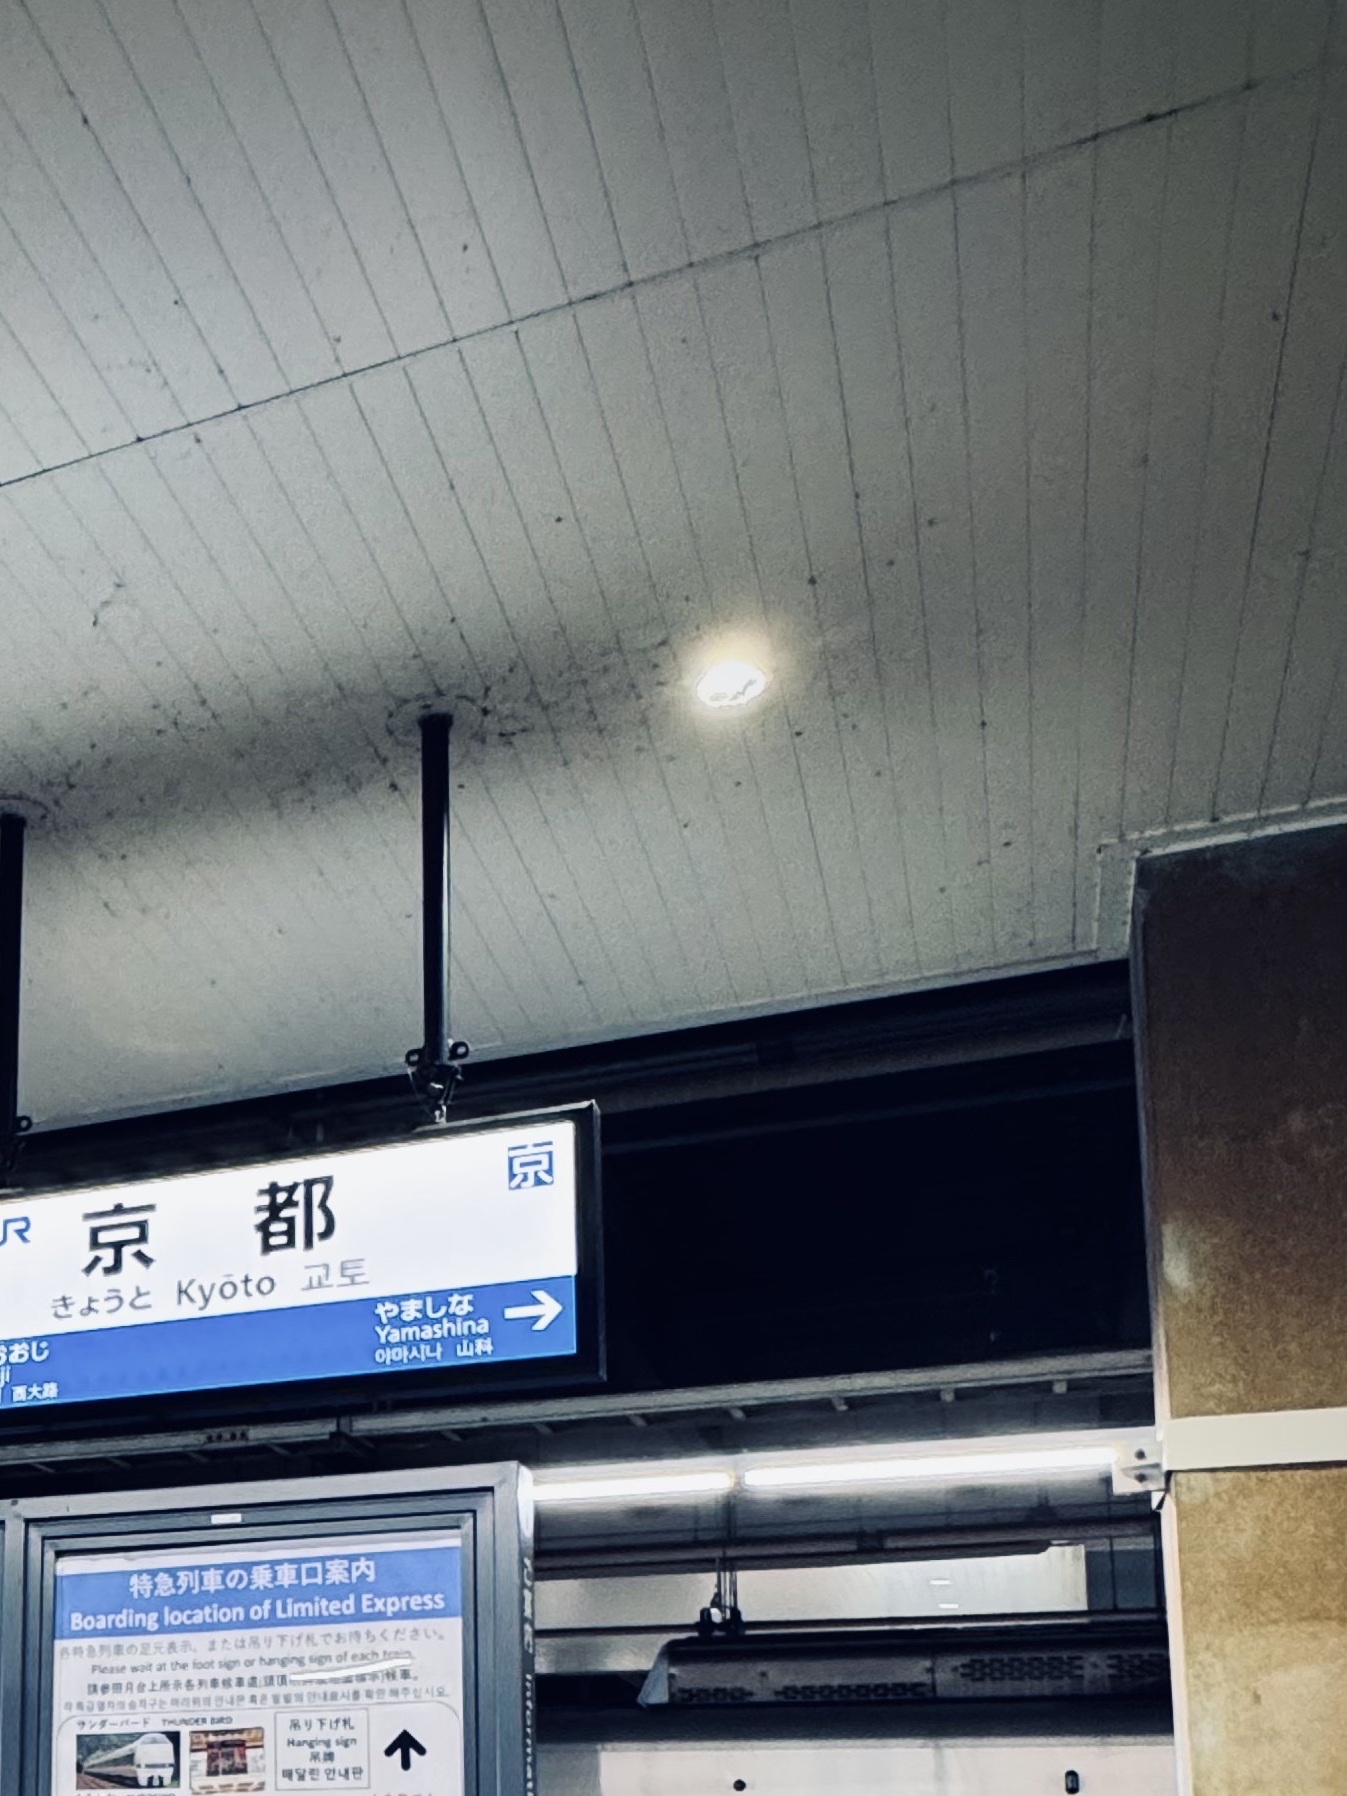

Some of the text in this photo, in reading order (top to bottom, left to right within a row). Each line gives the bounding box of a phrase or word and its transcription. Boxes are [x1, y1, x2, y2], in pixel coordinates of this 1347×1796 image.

[508, 1141, 554, 1191] 京
[51, 1258, 370, 1319] きょうと Kyōto 교토
[374, 1293, 474, 1325] やましな
[374, 1317, 490, 1345] Yamashina
[374, 1338, 494, 1365] 야마시나 山科
[130, 1556, 376, 1599] 特急列車の乗車口案内
[70, 1593, 445, 1631] Boarding location of Limited Express
[91, 1664, 127, 1675] Please
[170, 1660, 189, 1671] the
[259, 1653, 305, 1669] hanging
[308, 1652, 332, 1666] sign
[335, 1650, 347, 1663] of
[350, 1650, 379, 1662] each
[287, 1736, 357, 1749] Hanging sign
